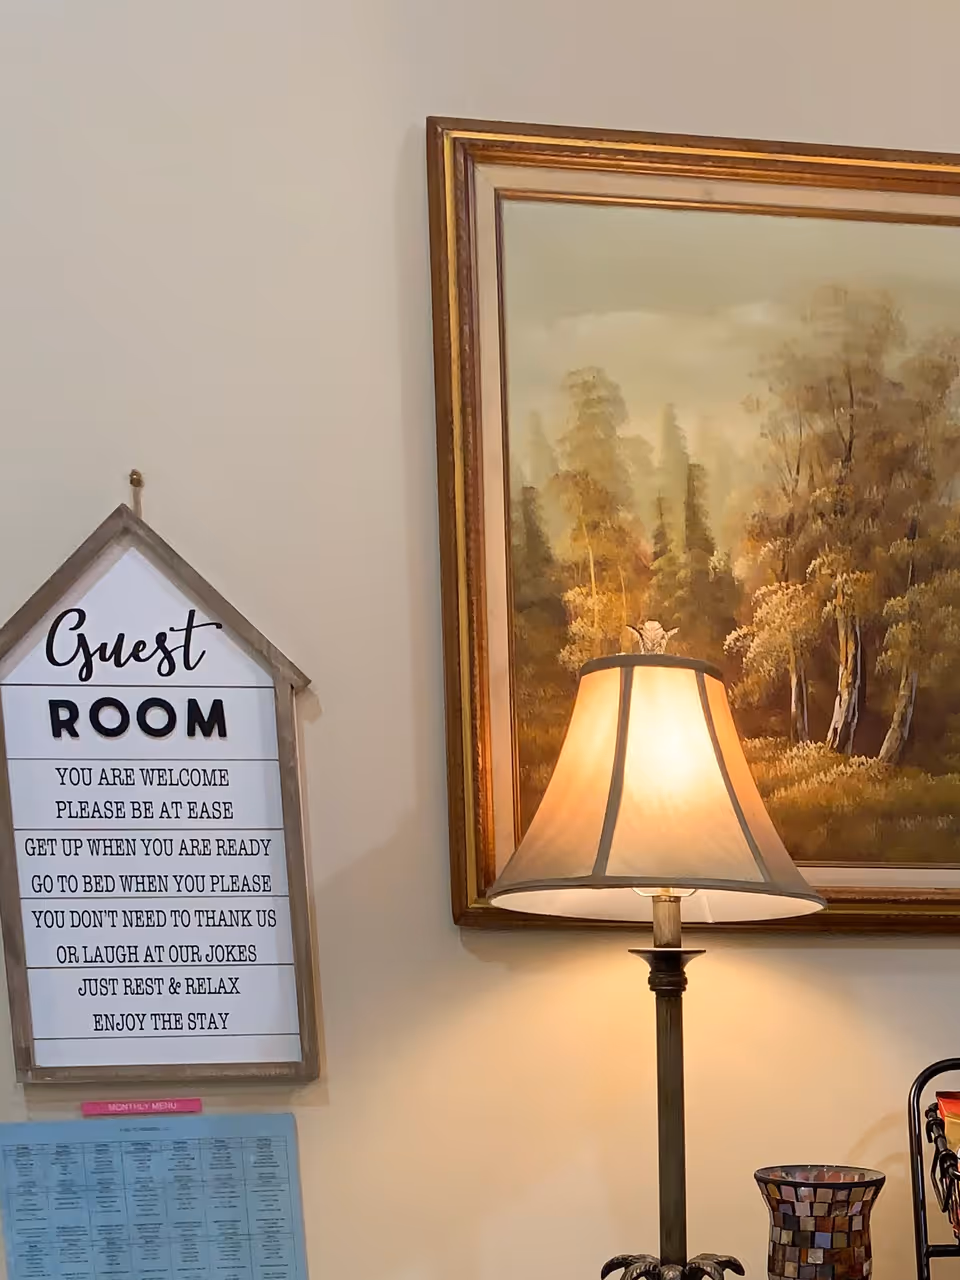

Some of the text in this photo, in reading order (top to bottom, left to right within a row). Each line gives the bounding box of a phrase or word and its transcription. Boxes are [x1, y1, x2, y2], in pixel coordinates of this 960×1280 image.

[45, 608, 222, 682] Guest
[49, 697, 227, 738] ROOM
[55, 768, 229, 786] YOU ARE WELCOME
[56, 801, 233, 819] PLEASE BE AT EASE
[25, 838, 271, 856] GET UP WHEN YOU ARE READY
[32, 875, 271, 893] GO TO BED WHEN YOU PLEASE
[31, 909, 276, 928] YOU DON'T NEED TO THANK US
[57, 945, 256, 963] OR LAUGH AT OUR JOKES
[78, 977, 240, 996] JUST REST & RELAX
[93, 1013, 229, 1031] ENJOY THE STAY
[108, 1101, 177, 1111] MONTHLY MENU
